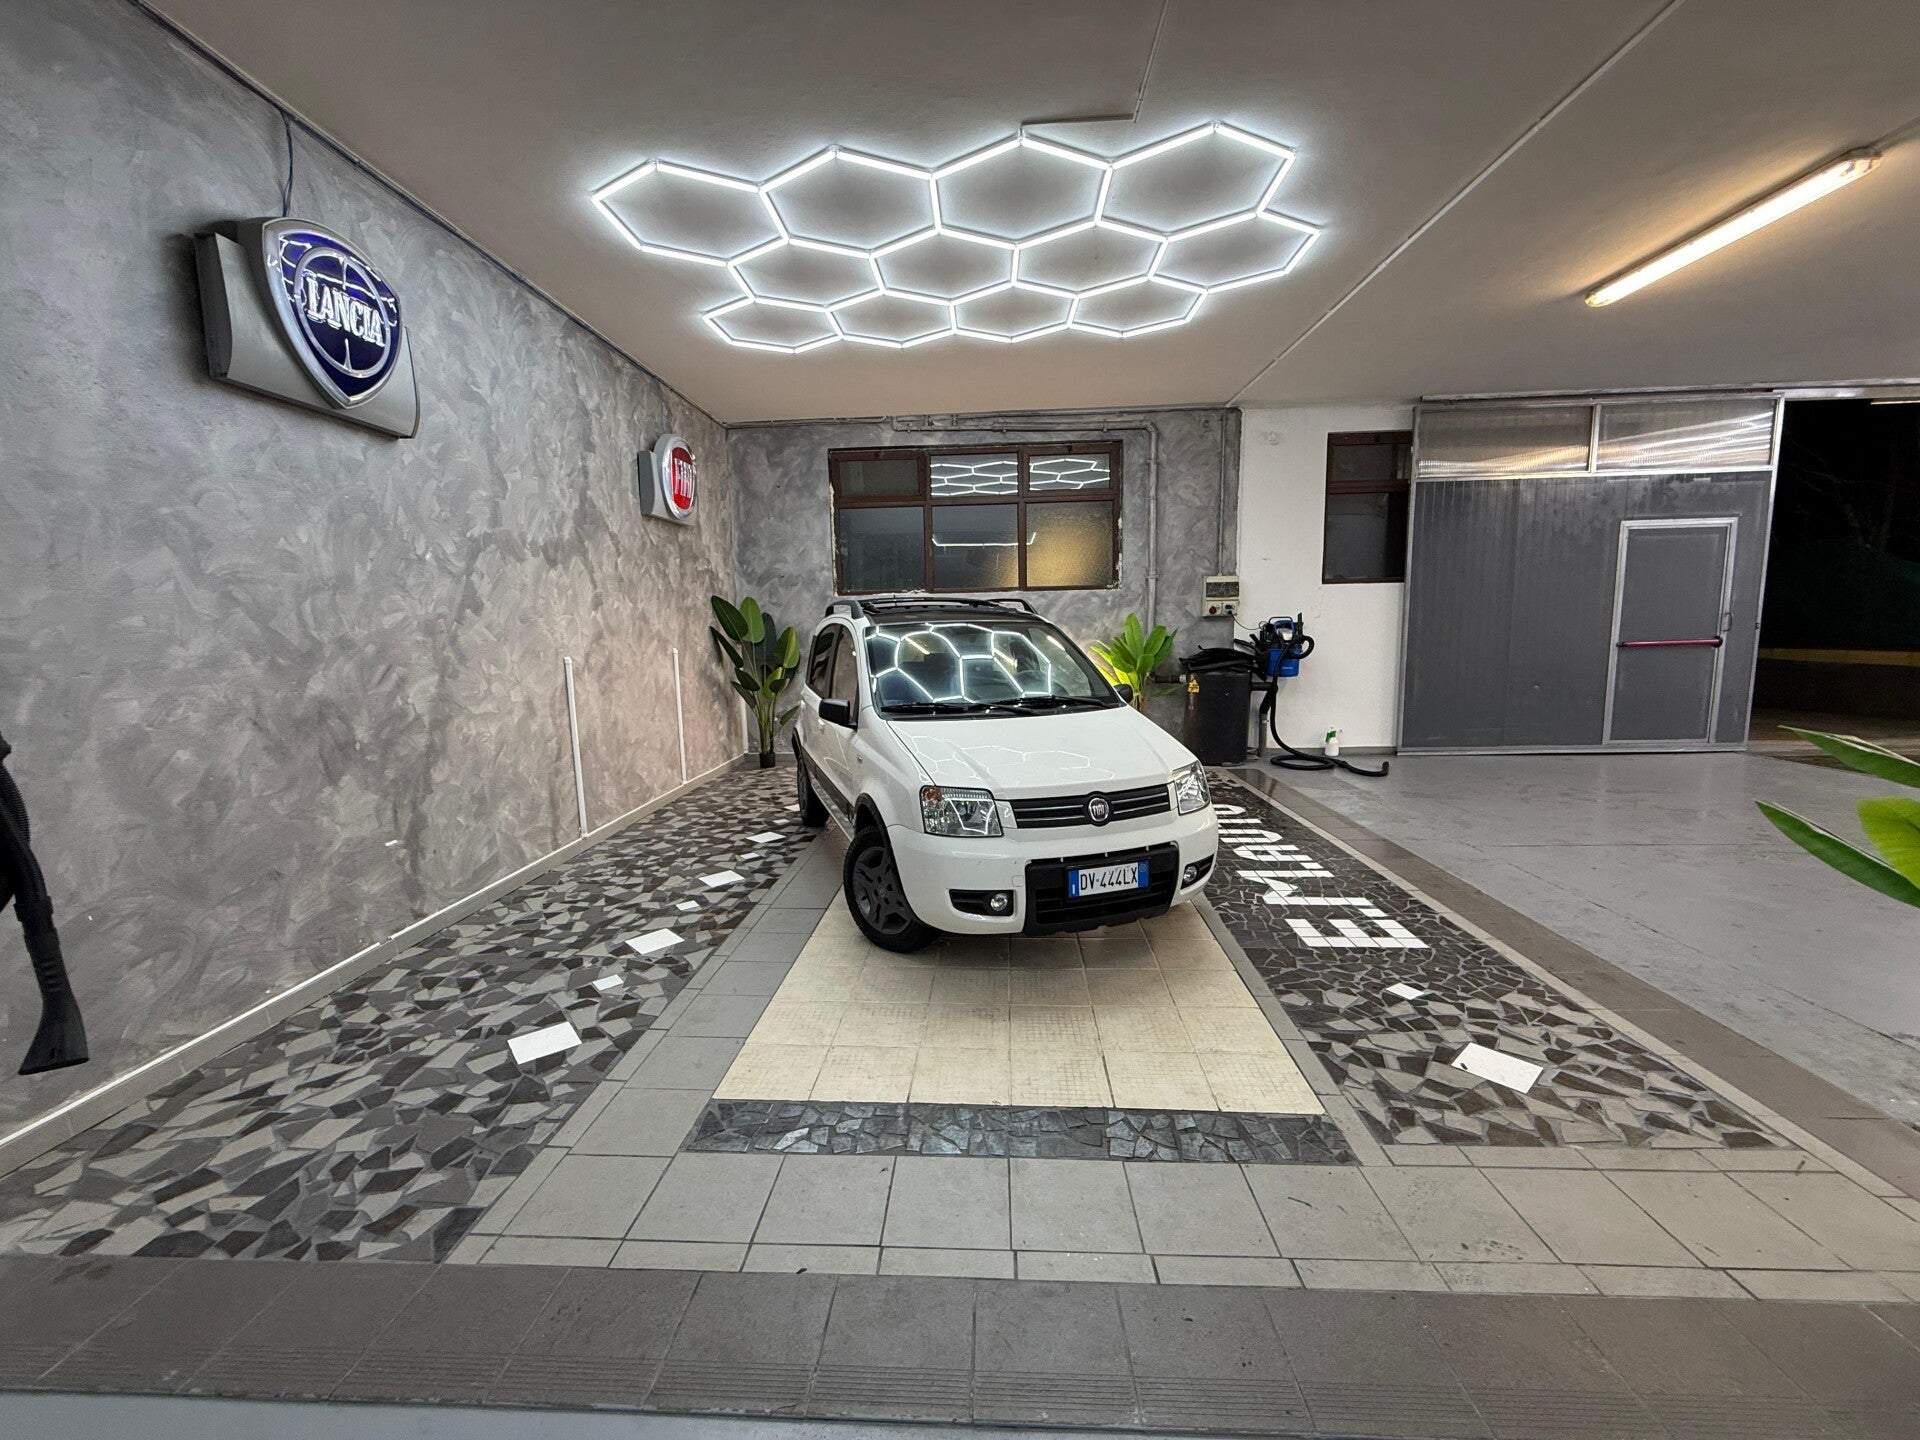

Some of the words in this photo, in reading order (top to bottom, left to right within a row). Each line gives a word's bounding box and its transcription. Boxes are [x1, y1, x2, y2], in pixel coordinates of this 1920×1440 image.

[303, 275, 386, 347] LANCIA
[675, 458, 692, 499] FIAT
[1092, 805, 1105, 816] FIAT
